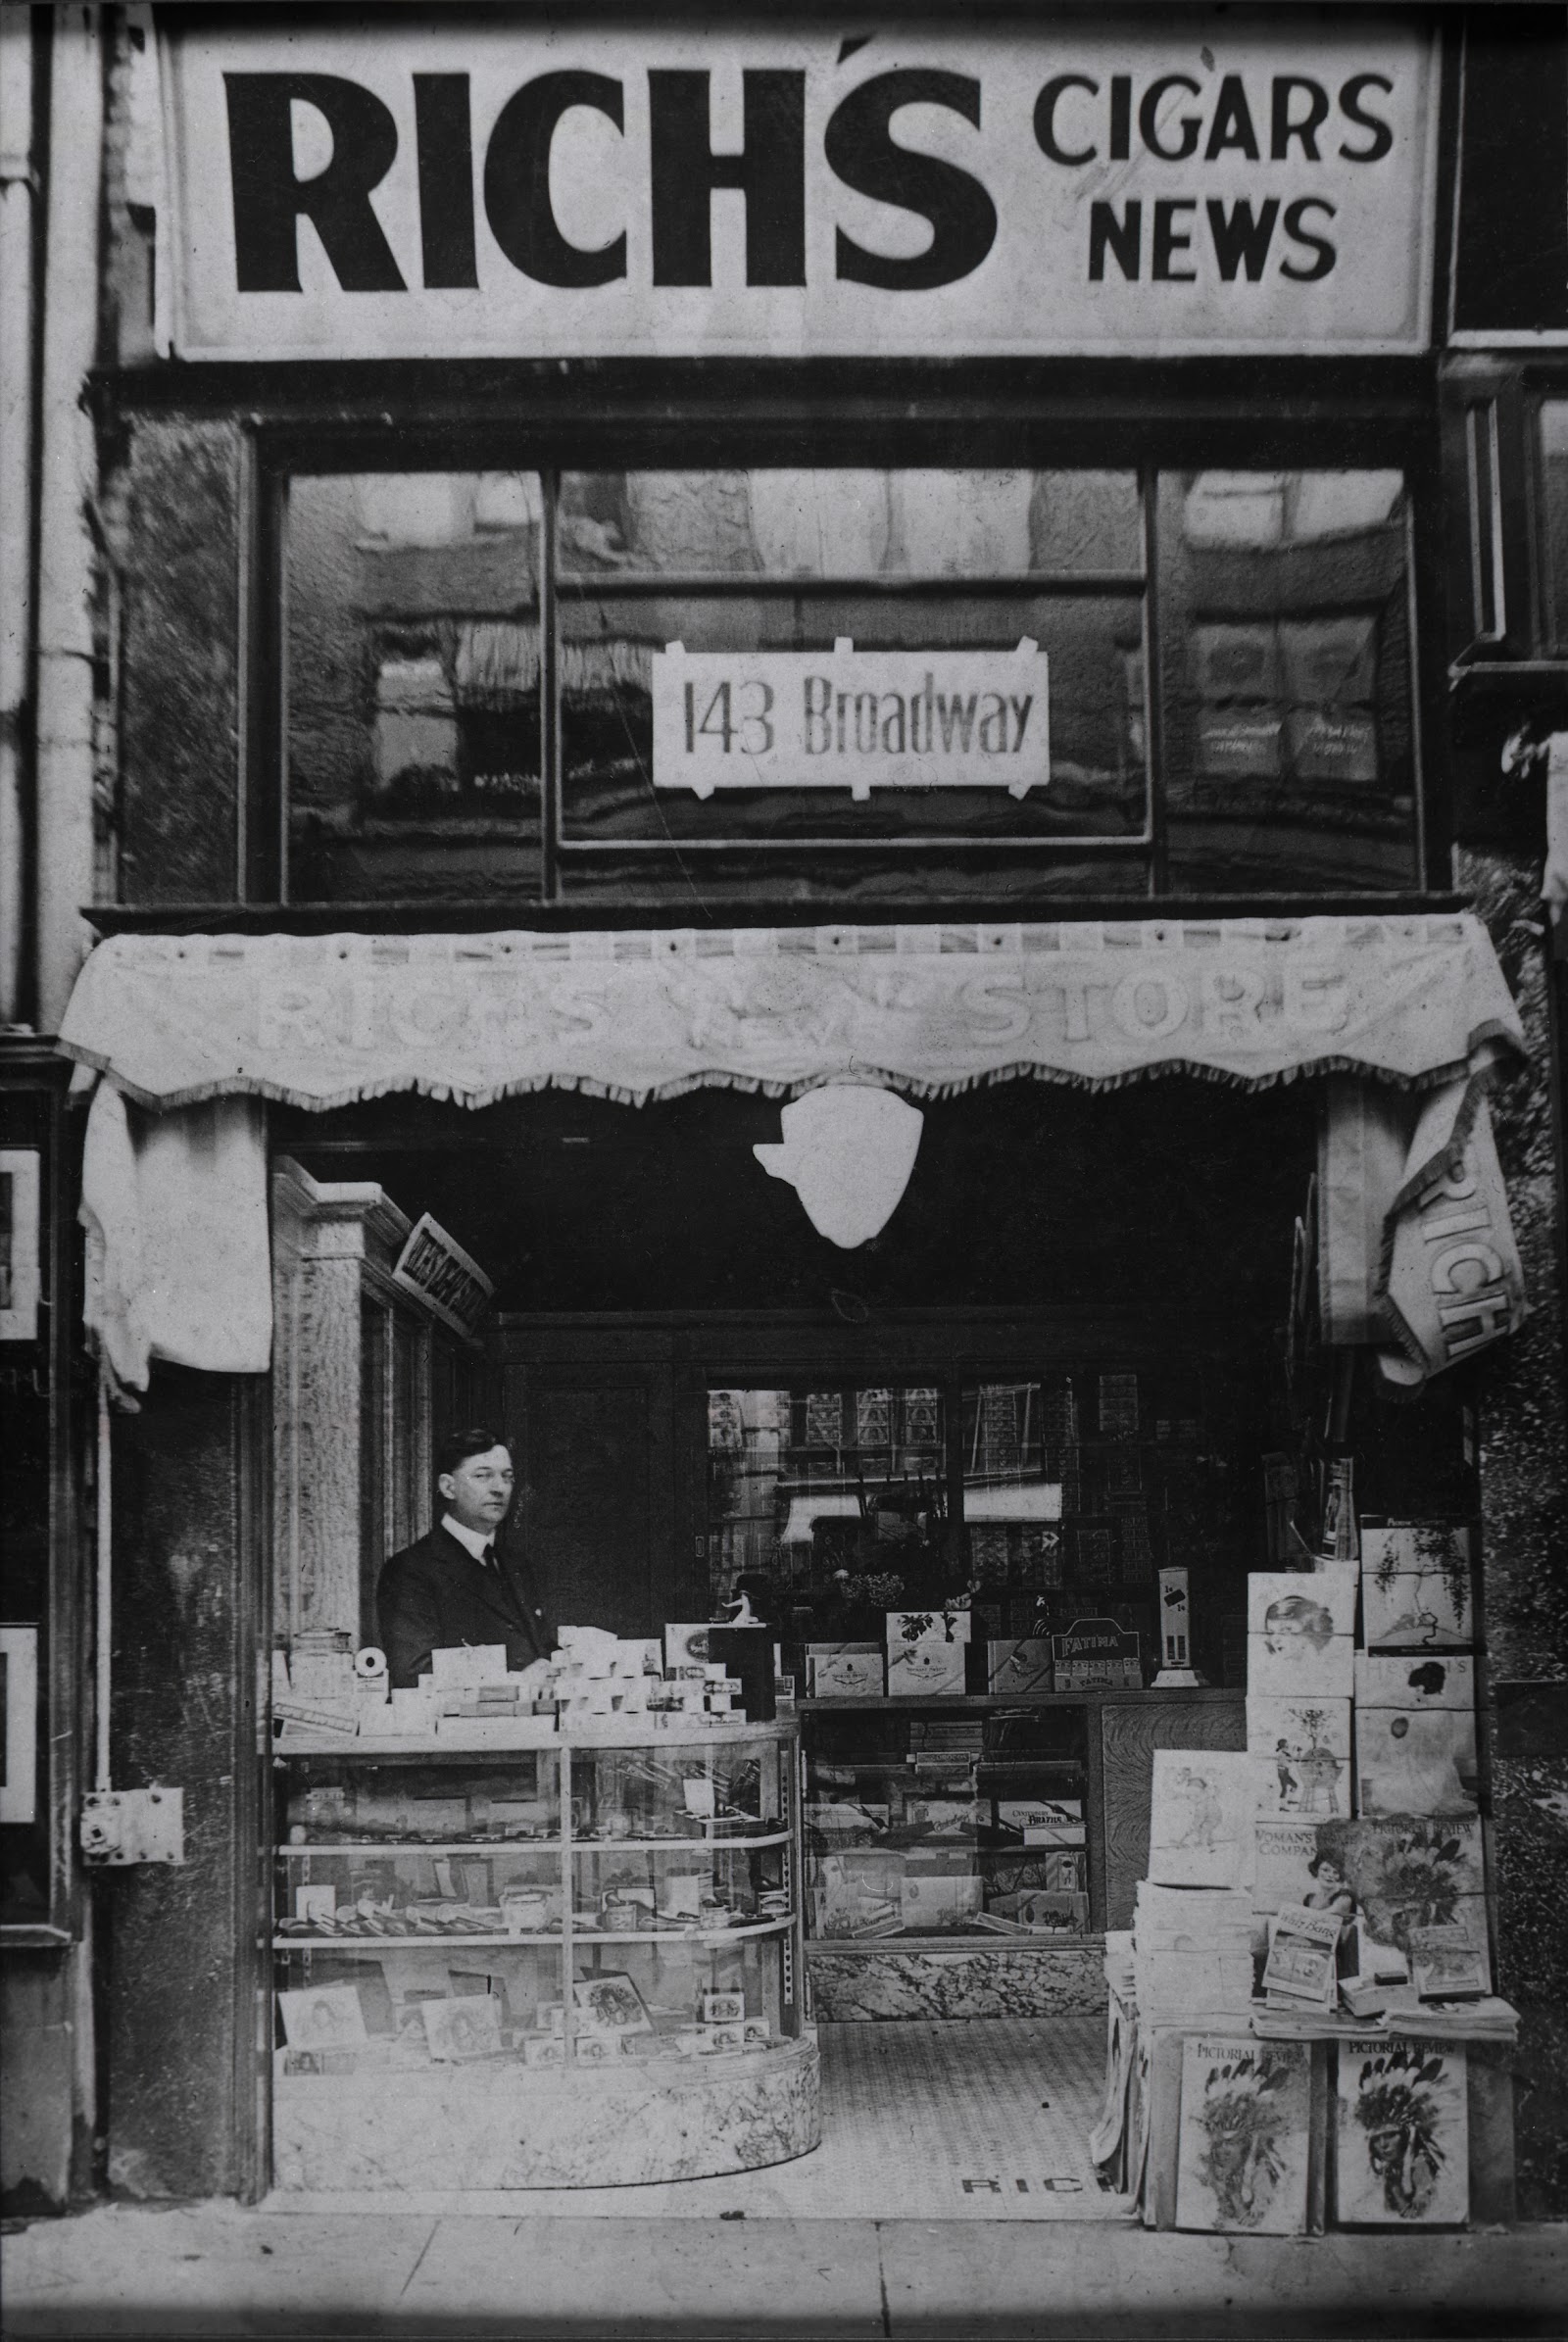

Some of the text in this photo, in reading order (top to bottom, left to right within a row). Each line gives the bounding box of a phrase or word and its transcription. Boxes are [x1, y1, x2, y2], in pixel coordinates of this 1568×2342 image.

[1032, 73, 1396, 167] CIGARS
[221, 37, 999, 292] RICH'S
[1087, 196, 1339, 283] NEWS
[685, 671, 1035, 756] 143 Broadway
[960, 965, 1348, 1045] STORE
[1060, 1635, 1119, 1658] FATIMA
[1079, 1677, 1114, 1687] FATIMA
[1197, 2042, 1255, 2061] PICTORIAL
[1348, 2040, 1457, 2056] PICTORIAL REVIEW
